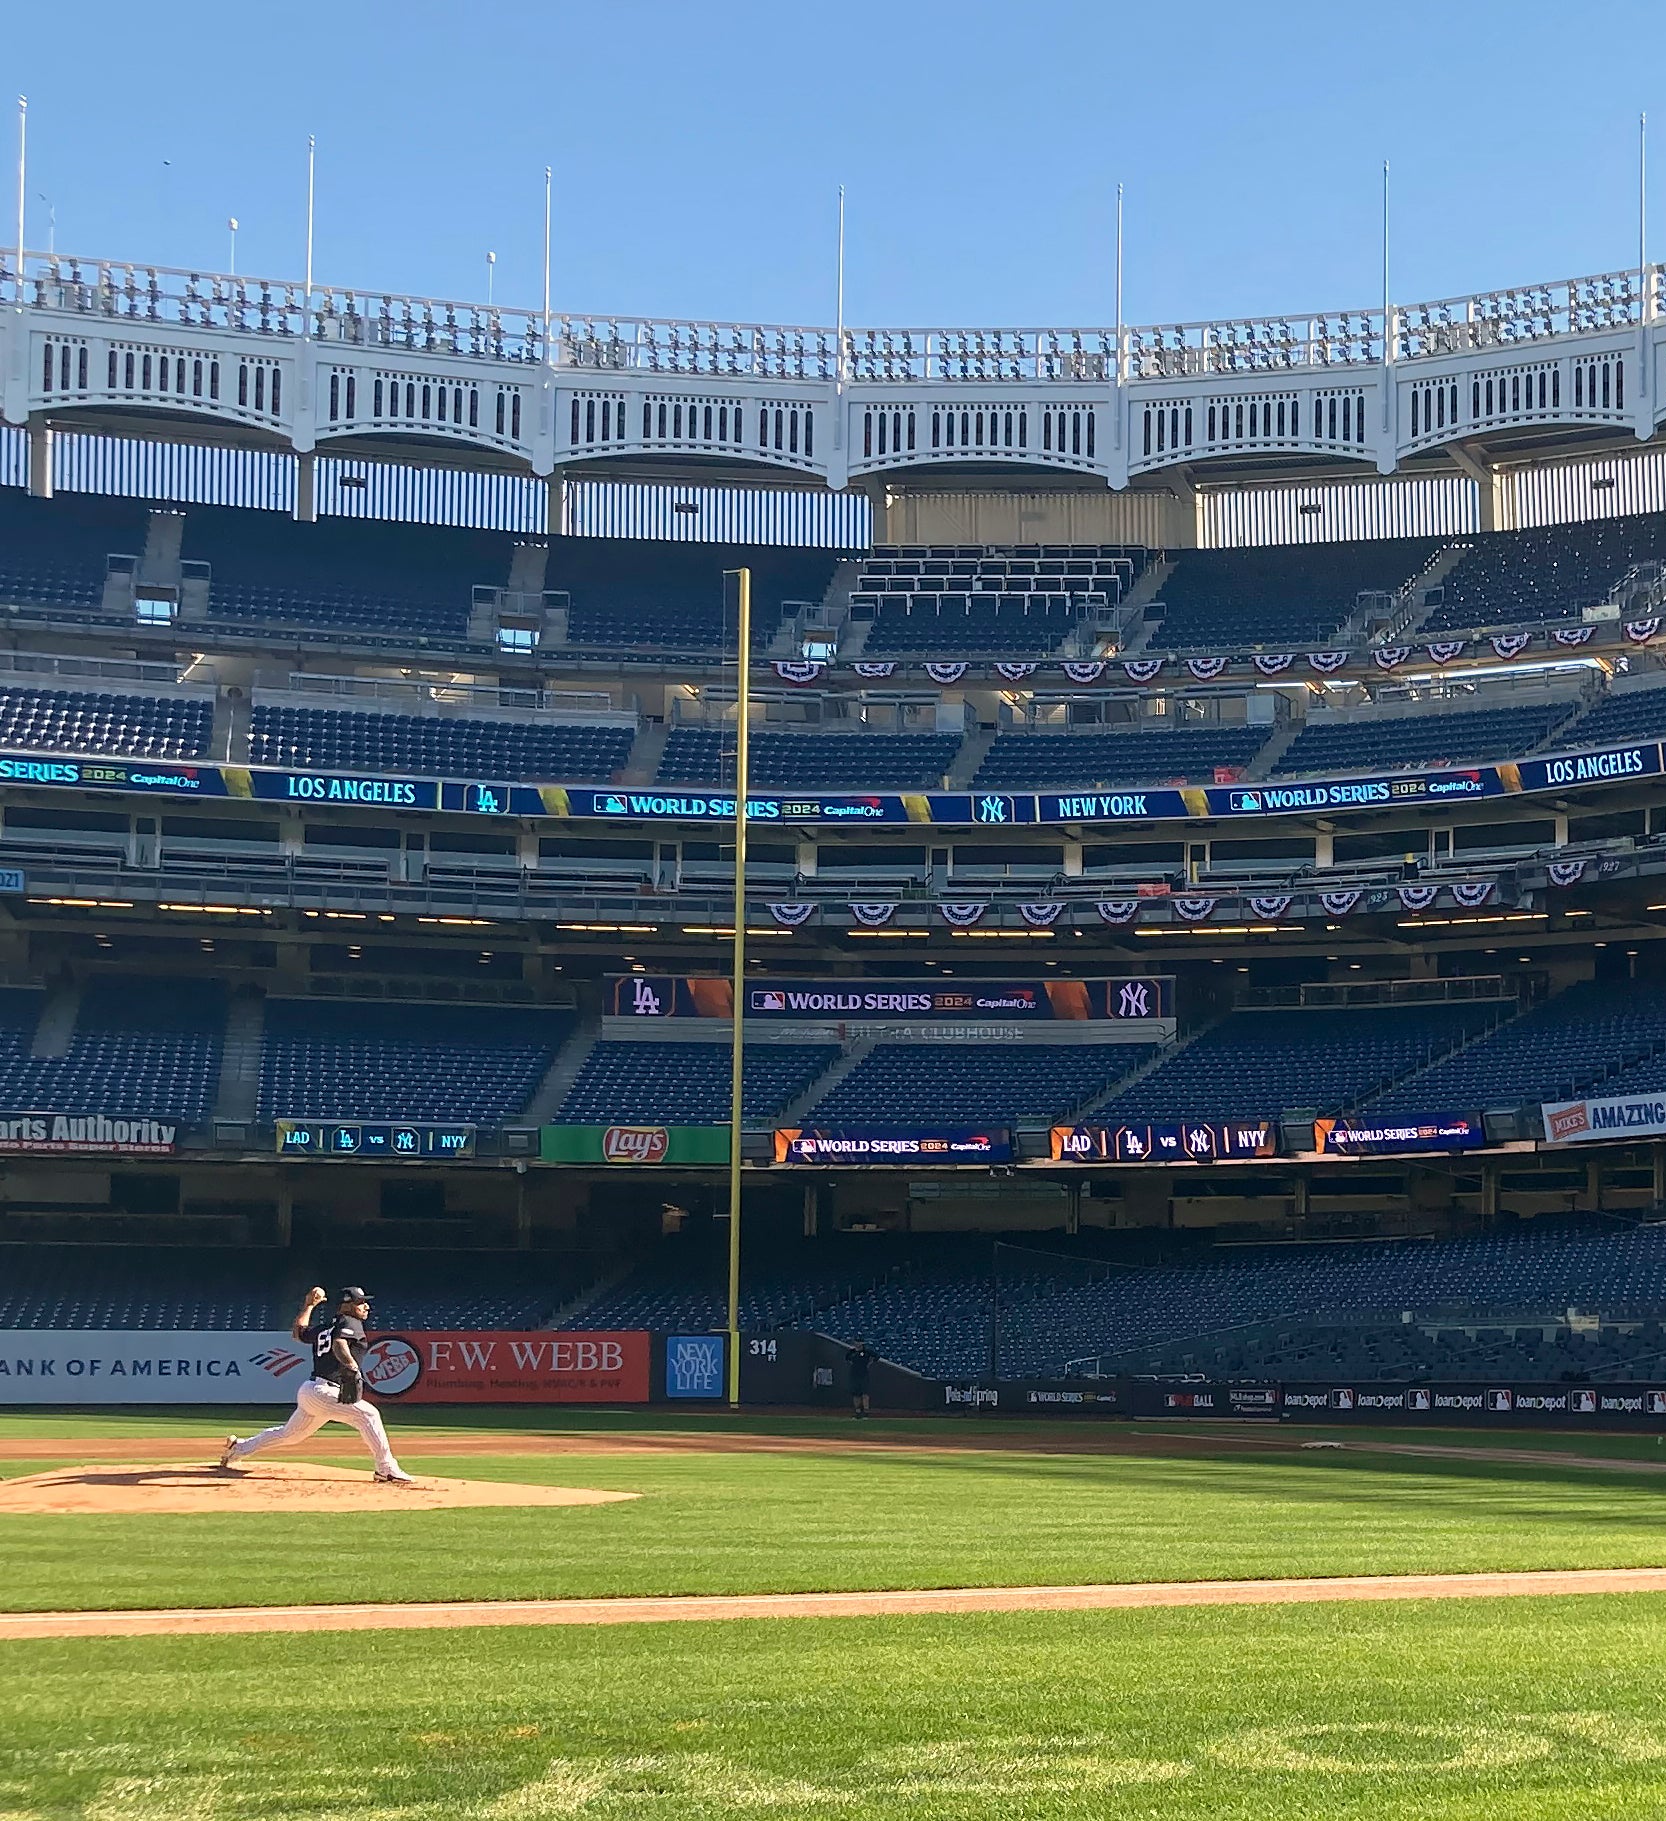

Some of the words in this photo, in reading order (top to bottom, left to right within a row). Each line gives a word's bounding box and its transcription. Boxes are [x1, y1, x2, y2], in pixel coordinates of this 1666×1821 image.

[0, 760, 79, 783] SERIES
[82, 769, 126, 781] 2024
[1546, 761, 1575, 783] LOS
[1577, 750, 1642, 778] ANGELES
[289, 777, 325, 798] LOS
[328, 781, 415, 803] ANGELES
[477, 784, 499, 813] LA
[1264, 789, 1327, 808] WORLD
[1330, 783, 1390, 803] SERIES
[1391, 782, 1426, 795] 2024
[629, 796, 706, 815] WORLD
[782, 804, 820, 815] 2024
[980, 795, 1006, 822] NY
[1058, 797, 1096, 817] NEW
[1100, 795, 1148, 816] YORK
[633, 979, 660, 1014] LA
[788, 993, 861, 1009] WORLD
[864, 993, 931, 1011] SERIES
[934, 996, 972, 1007] 2024
[1119, 982, 1149, 1017] NY
[1592, 1102, 1666, 1129] AMAZING
[52, 1114, 176, 1144] Authority
[286, 1131, 309, 1144] LAD
[1348, 1129, 1383, 1142] WORLD
[1384, 1127, 1418, 1140] SERIES
[340, 1130, 354, 1148] LA
[397, 1132, 415, 1149] NY
[442, 1136, 467, 1148] NYY
[608, 1129, 664, 1160] Lay's
[816, 1140, 869, 1152] WORLD
[871, 1140, 919, 1153] SERIES
[920, 1142, 948, 1150] 2024
[1063, 1135, 1091, 1152] LAD
[1126, 1130, 1144, 1153] LA
[1190, 1129, 1210, 1152] NY
[1238, 1130, 1266, 1147] NYY
[427, 1341, 497, 1371] F.W.
[508, 1341, 624, 1371] WEBB
[677, 1343, 716, 1360] NEW
[750, 1339, 777, 1355] 314
[670, 1358, 718, 1376] YORK
[767, 1354, 777, 1362] FT
[66, 1359, 102, 1376] OF
[110, 1359, 242, 1377] AMERICA
[373, 1355, 410, 1380] WEBB
[676, 1373, 713, 1389] LIFE
[1194, 1394, 1214, 1407] BALL
[1358, 1393, 1403, 1409] loanDepot
[1435, 1393, 1482, 1410] loanDepot
[1516, 1394, 1566, 1411] loanDepot
[1601, 1395, 1642, 1412] loanDepot
